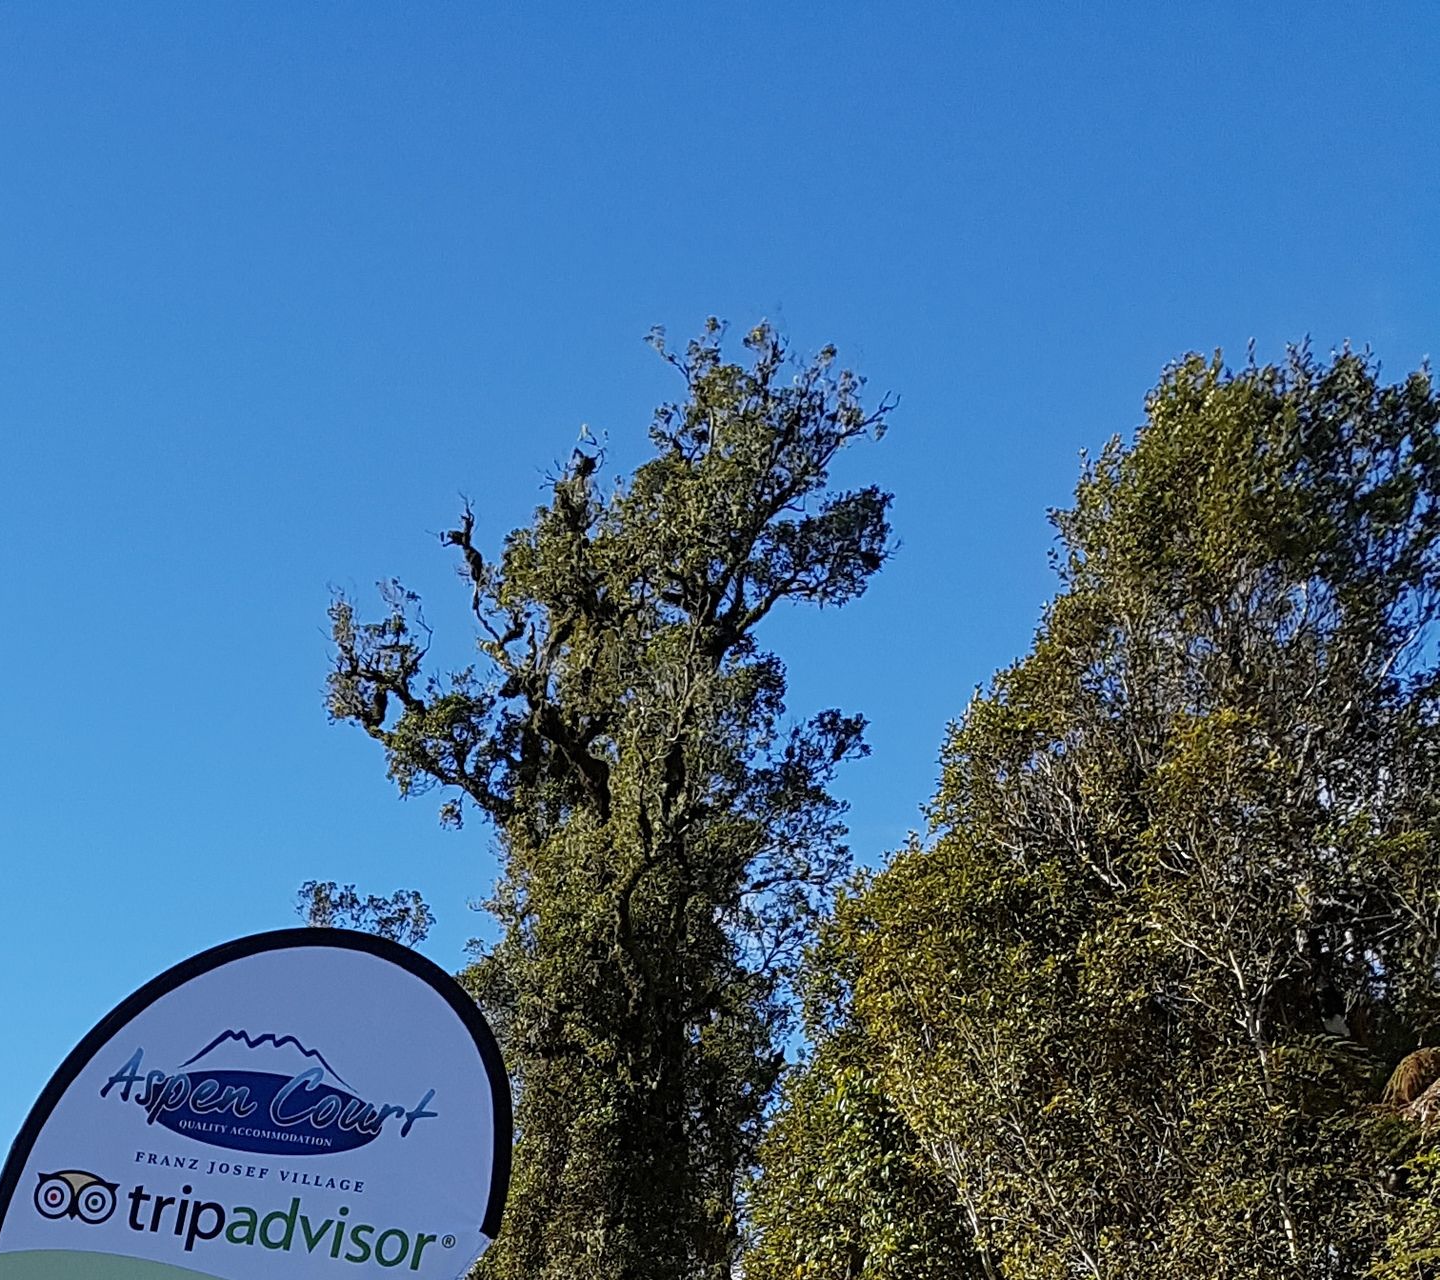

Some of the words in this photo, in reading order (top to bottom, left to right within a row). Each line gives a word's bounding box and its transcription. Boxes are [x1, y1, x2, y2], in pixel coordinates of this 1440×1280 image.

[100, 1047, 258, 1126] Aspen
[270, 1067, 439, 1138] Court
[178, 1119, 228, 1134] QUALITY
[230, 1126, 333, 1147] ACCOMMODATION
[135, 1151, 199, 1170] FRANZ
[206, 1161, 269, 1180] JOSEF
[279, 1170, 365, 1193] VILLAGE
